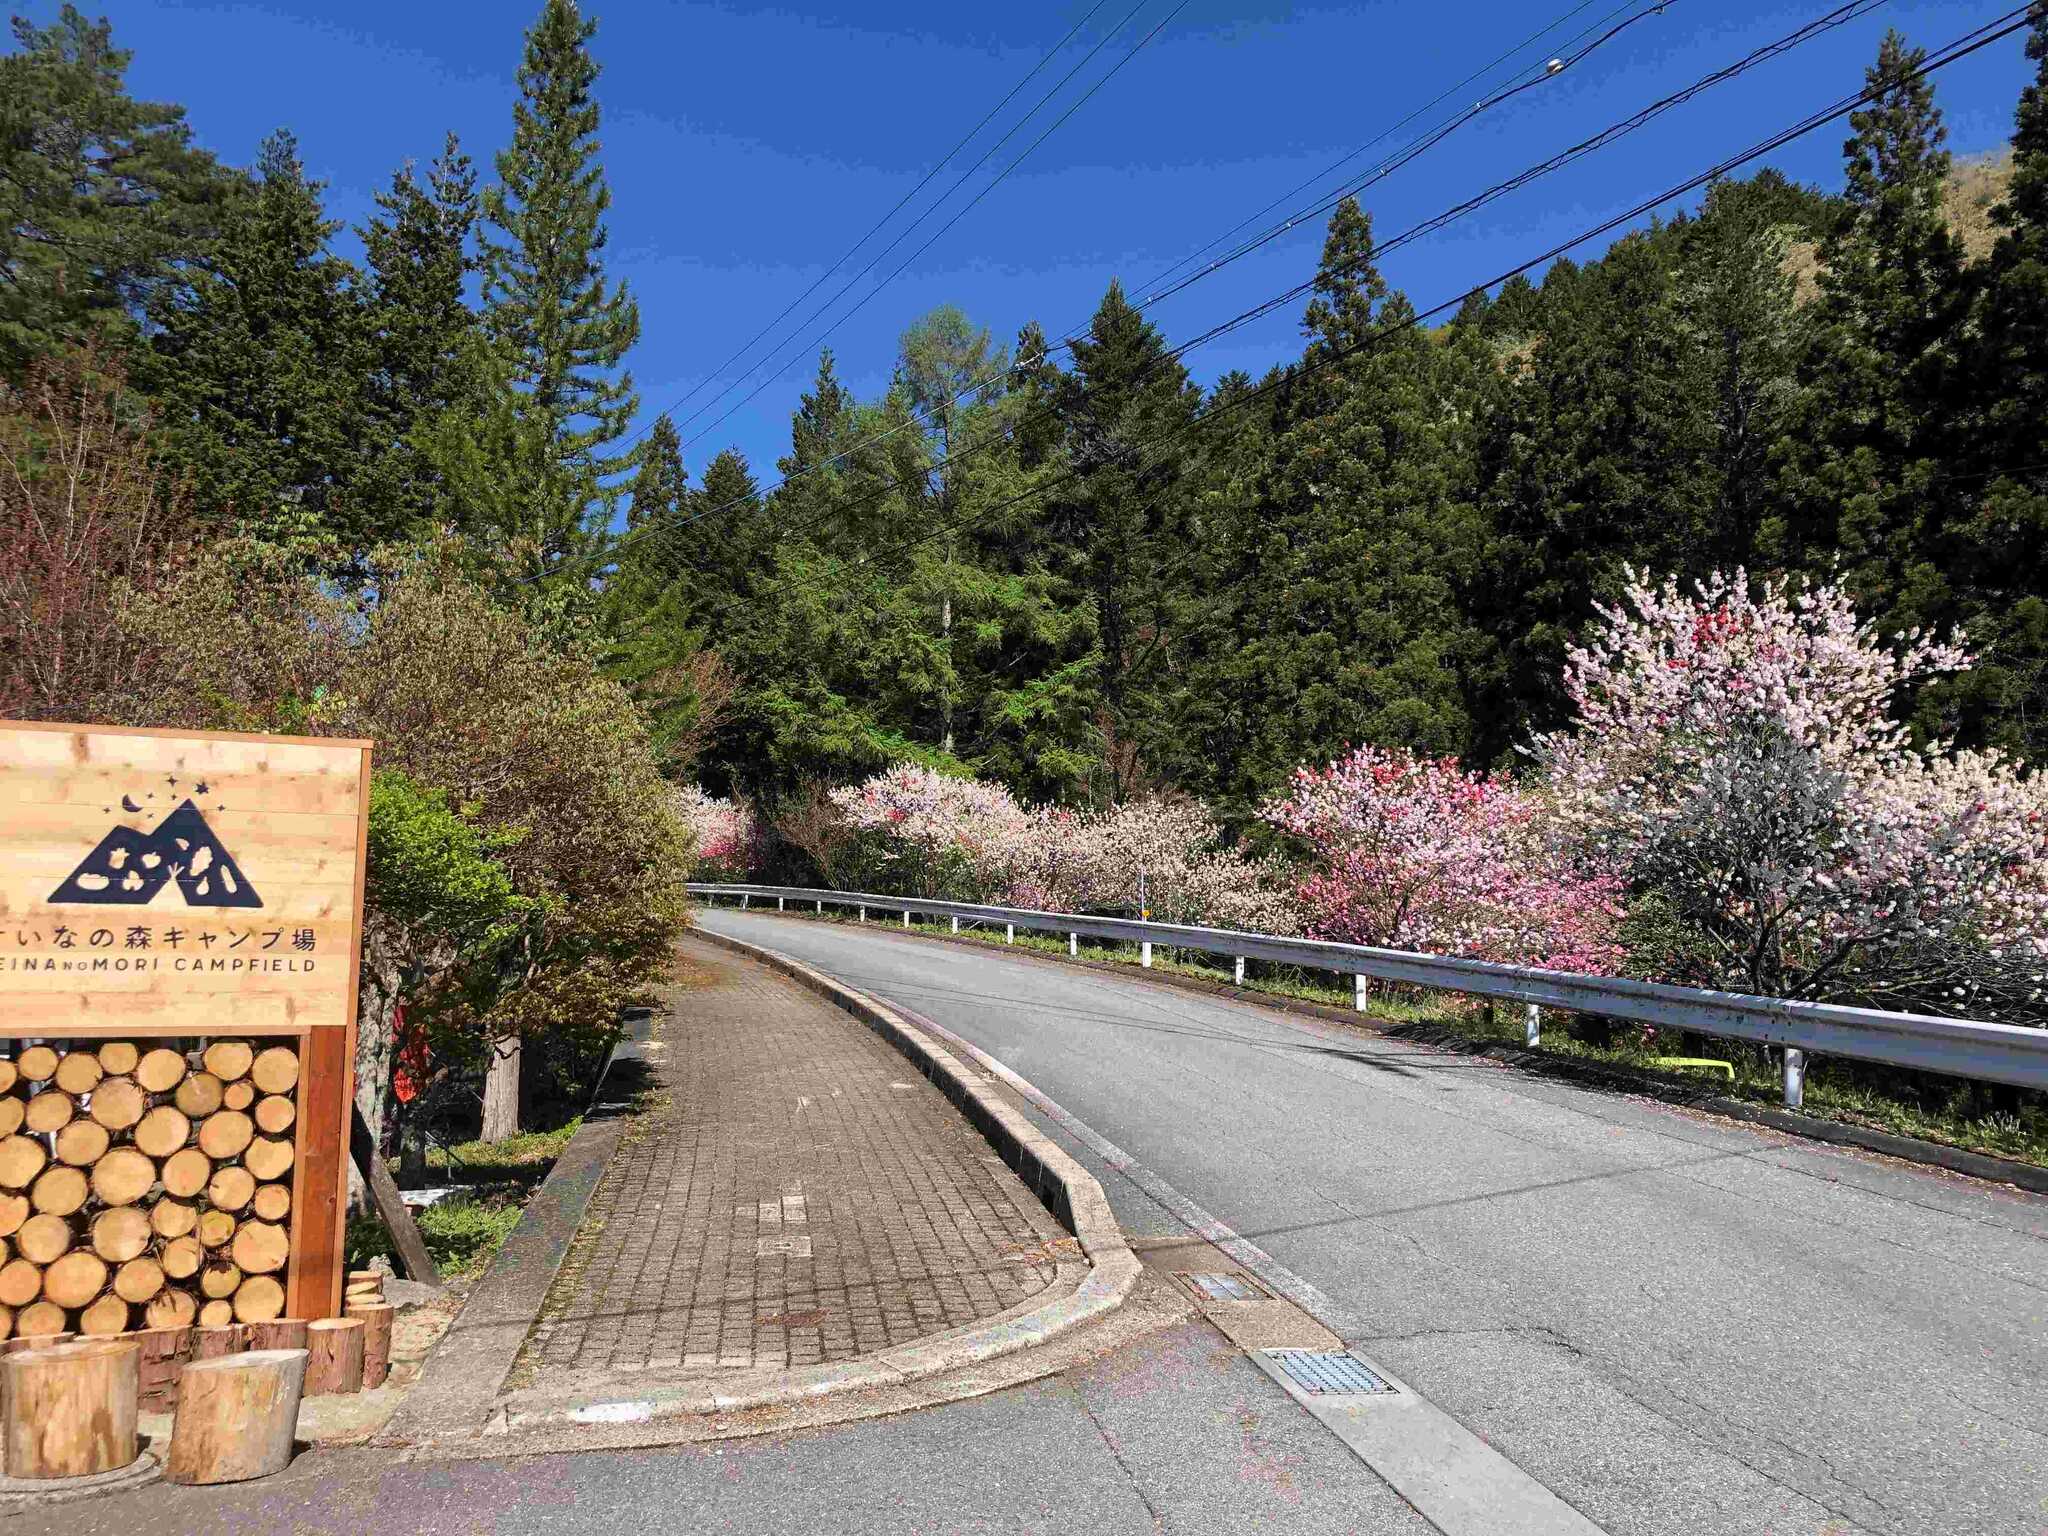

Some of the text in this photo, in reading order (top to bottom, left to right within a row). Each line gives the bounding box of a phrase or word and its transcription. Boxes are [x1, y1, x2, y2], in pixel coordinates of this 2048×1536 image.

[0, 925, 317, 952] いなの森キャンプ場
[174, 957, 316, 972] CAMPFIELD
